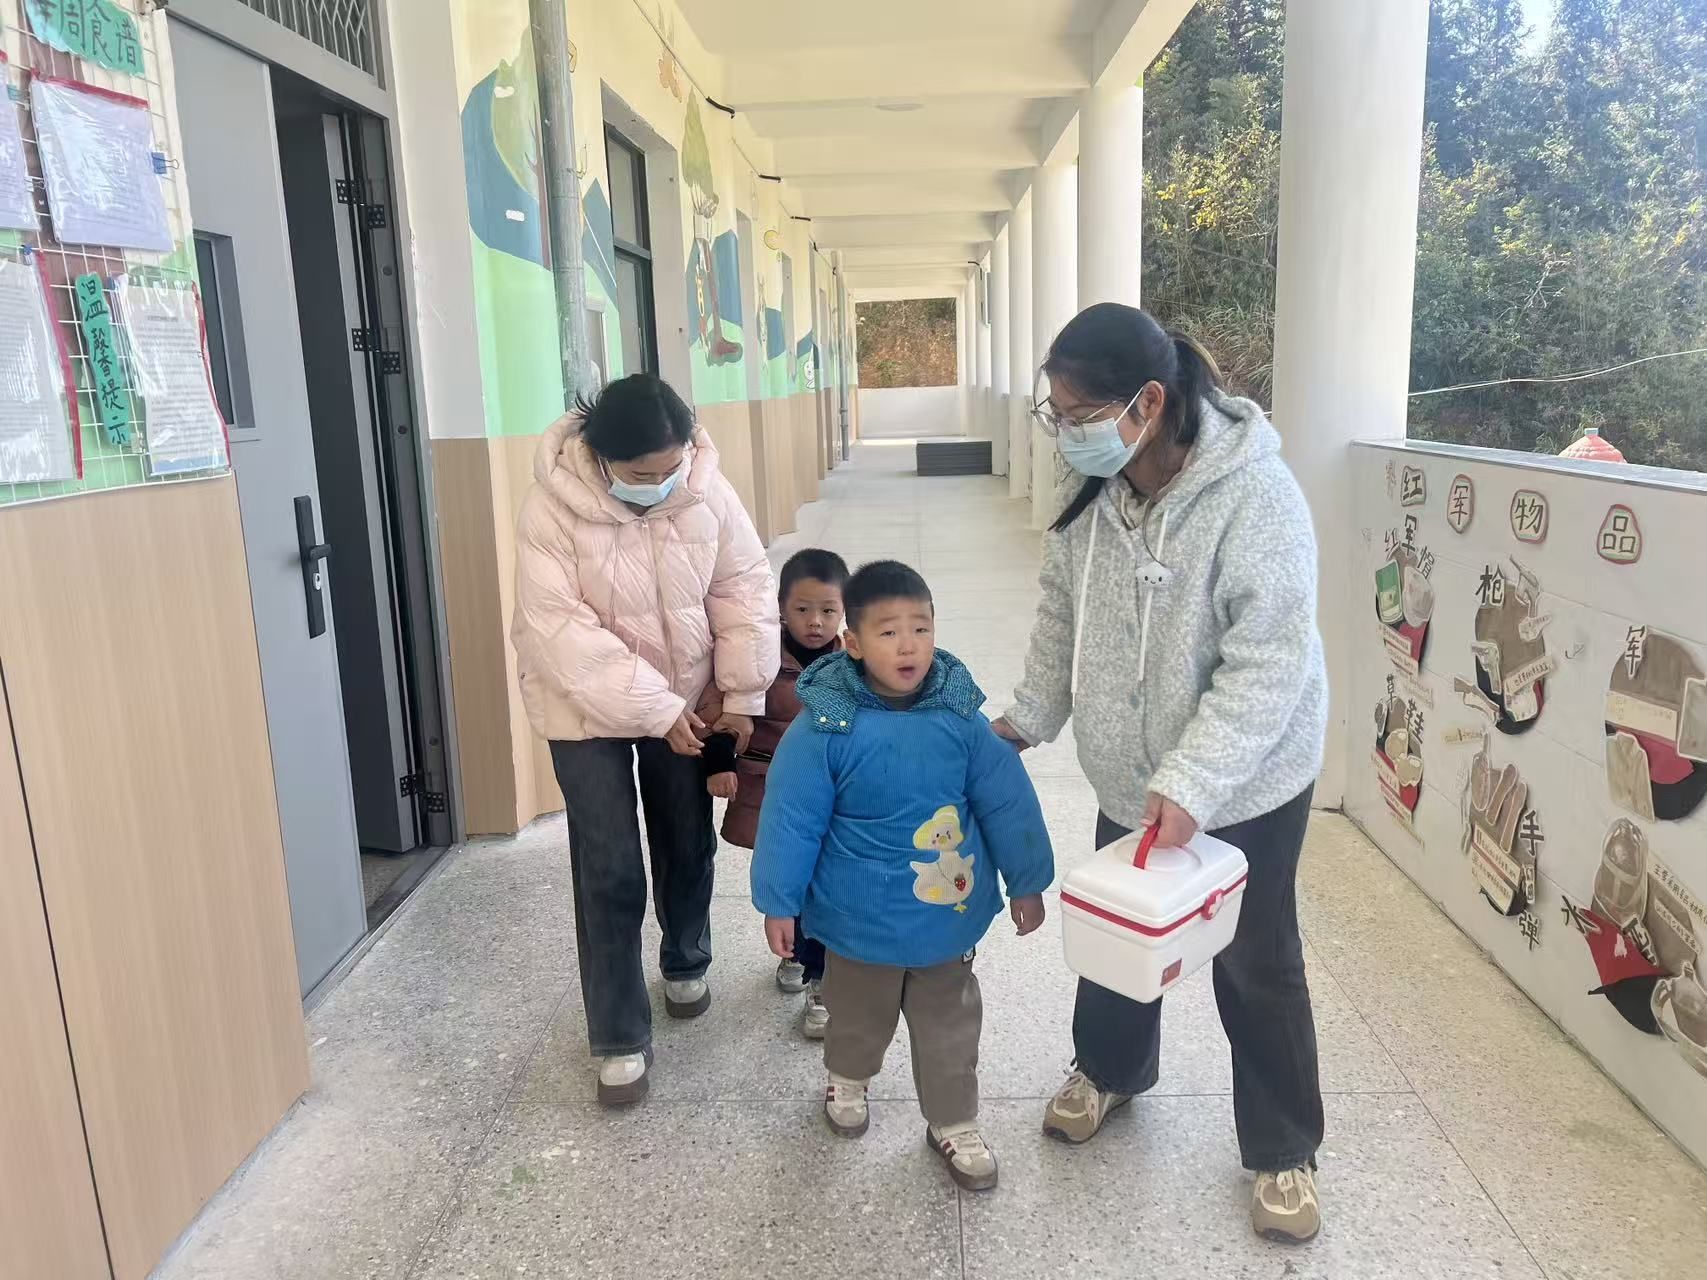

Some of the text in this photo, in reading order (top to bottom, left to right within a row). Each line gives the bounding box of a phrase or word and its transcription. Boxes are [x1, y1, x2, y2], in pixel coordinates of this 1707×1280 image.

[81, 279, 127, 445] 温馨提示
[1402, 470, 1636, 555] 红军物品
[1475, 564, 1504, 604] 枪
[1626, 625, 1646, 676] 军
